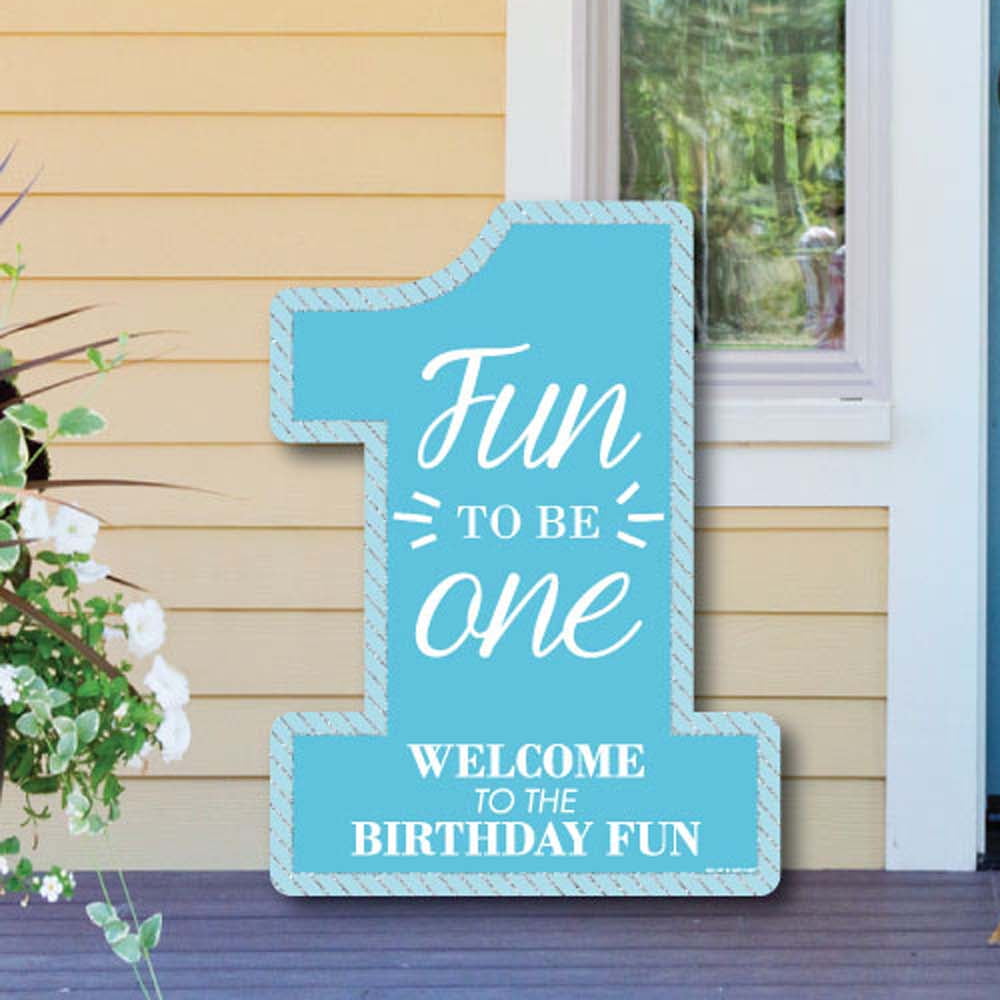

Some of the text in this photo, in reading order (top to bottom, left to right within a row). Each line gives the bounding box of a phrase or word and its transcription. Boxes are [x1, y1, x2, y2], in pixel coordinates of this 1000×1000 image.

[417, 343, 641, 470] Fun
[457, 504, 600, 539] TO BE
[415, 571, 643, 659] one
[407, 743, 645, 779] WELCOME
[475, 787, 578, 814] TO THE
[351, 821, 701, 857] BIRTHDAY FUN
